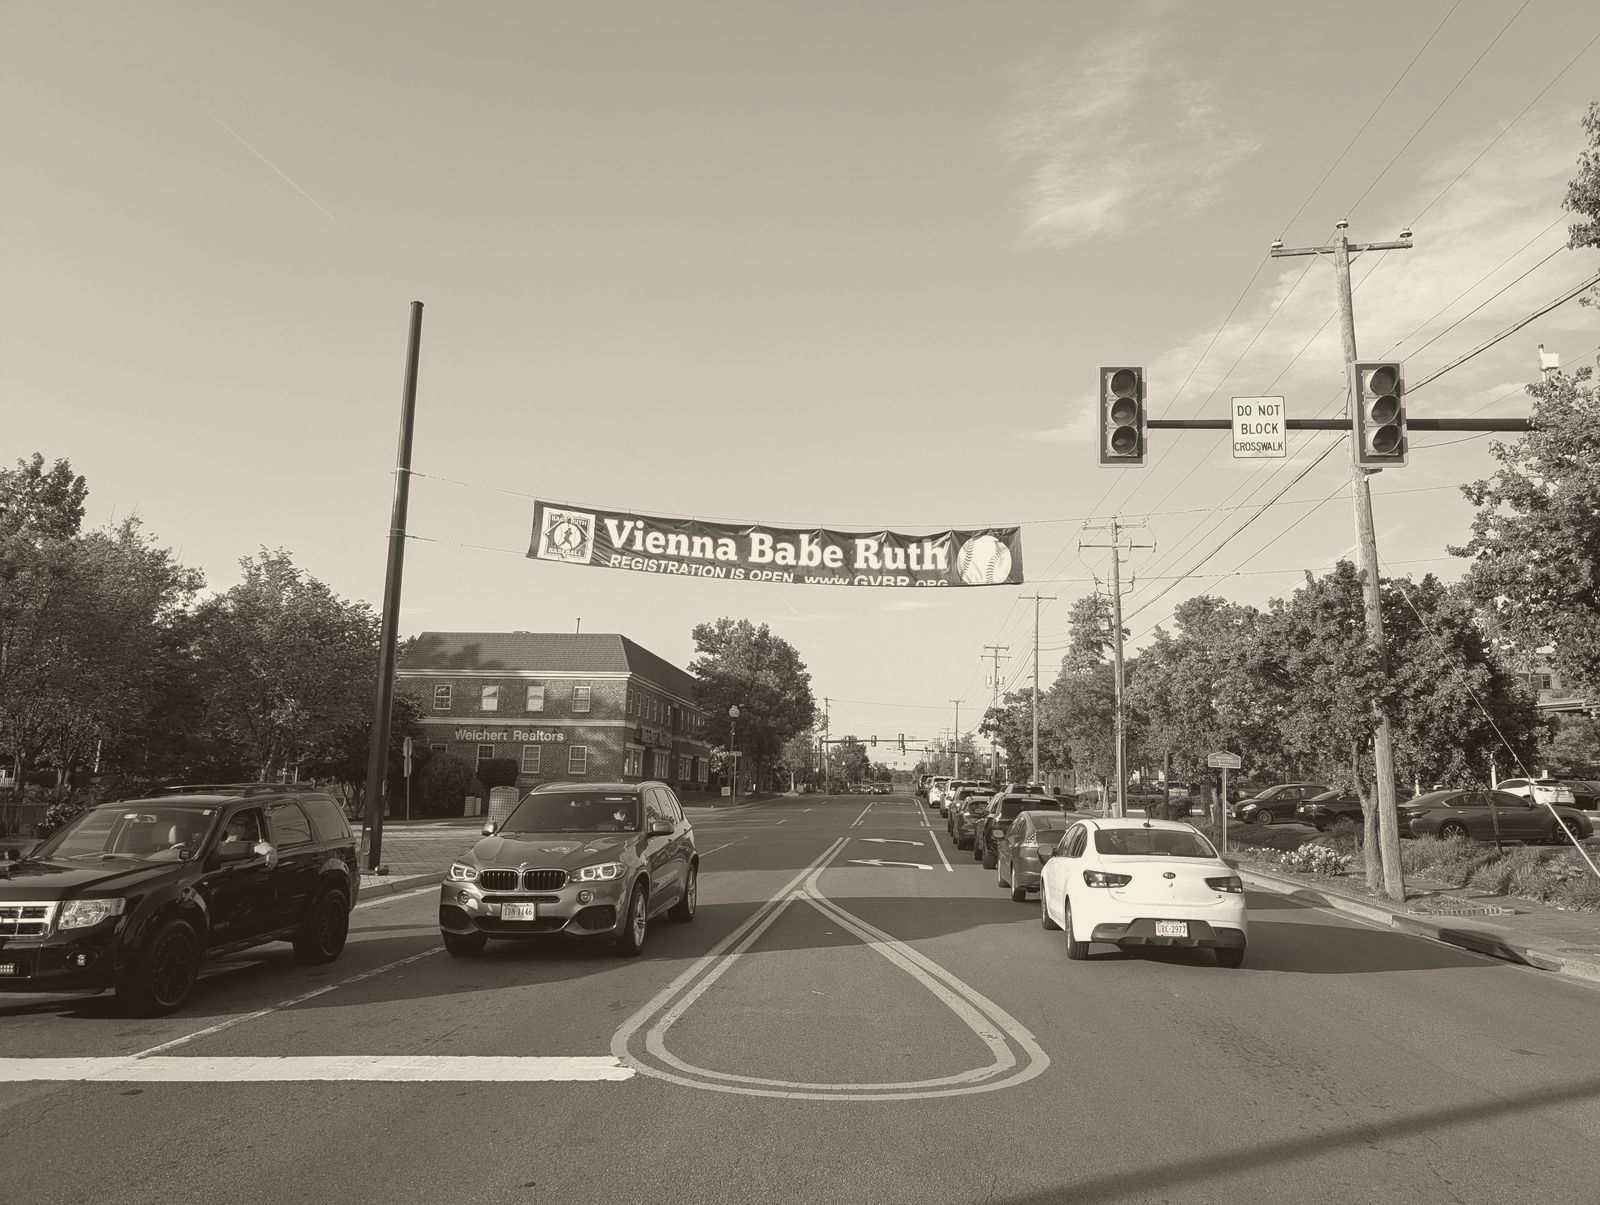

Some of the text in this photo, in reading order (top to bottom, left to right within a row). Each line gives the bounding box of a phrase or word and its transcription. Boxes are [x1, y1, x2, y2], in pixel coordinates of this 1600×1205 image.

[1237, 404, 1280, 416] DO NOT
[1241, 422, 1279, 435] BLOCK
[1234, 441, 1284, 452] CROSSWALK
[603, 518, 948, 570] Vienna Babe Ruth
[610, 554, 726, 578] REGISTRATION
[730, 567, 745, 580] IS
[750, 569, 794, 583] OPEN
[455, 729, 564, 742] Weichert Realtors
